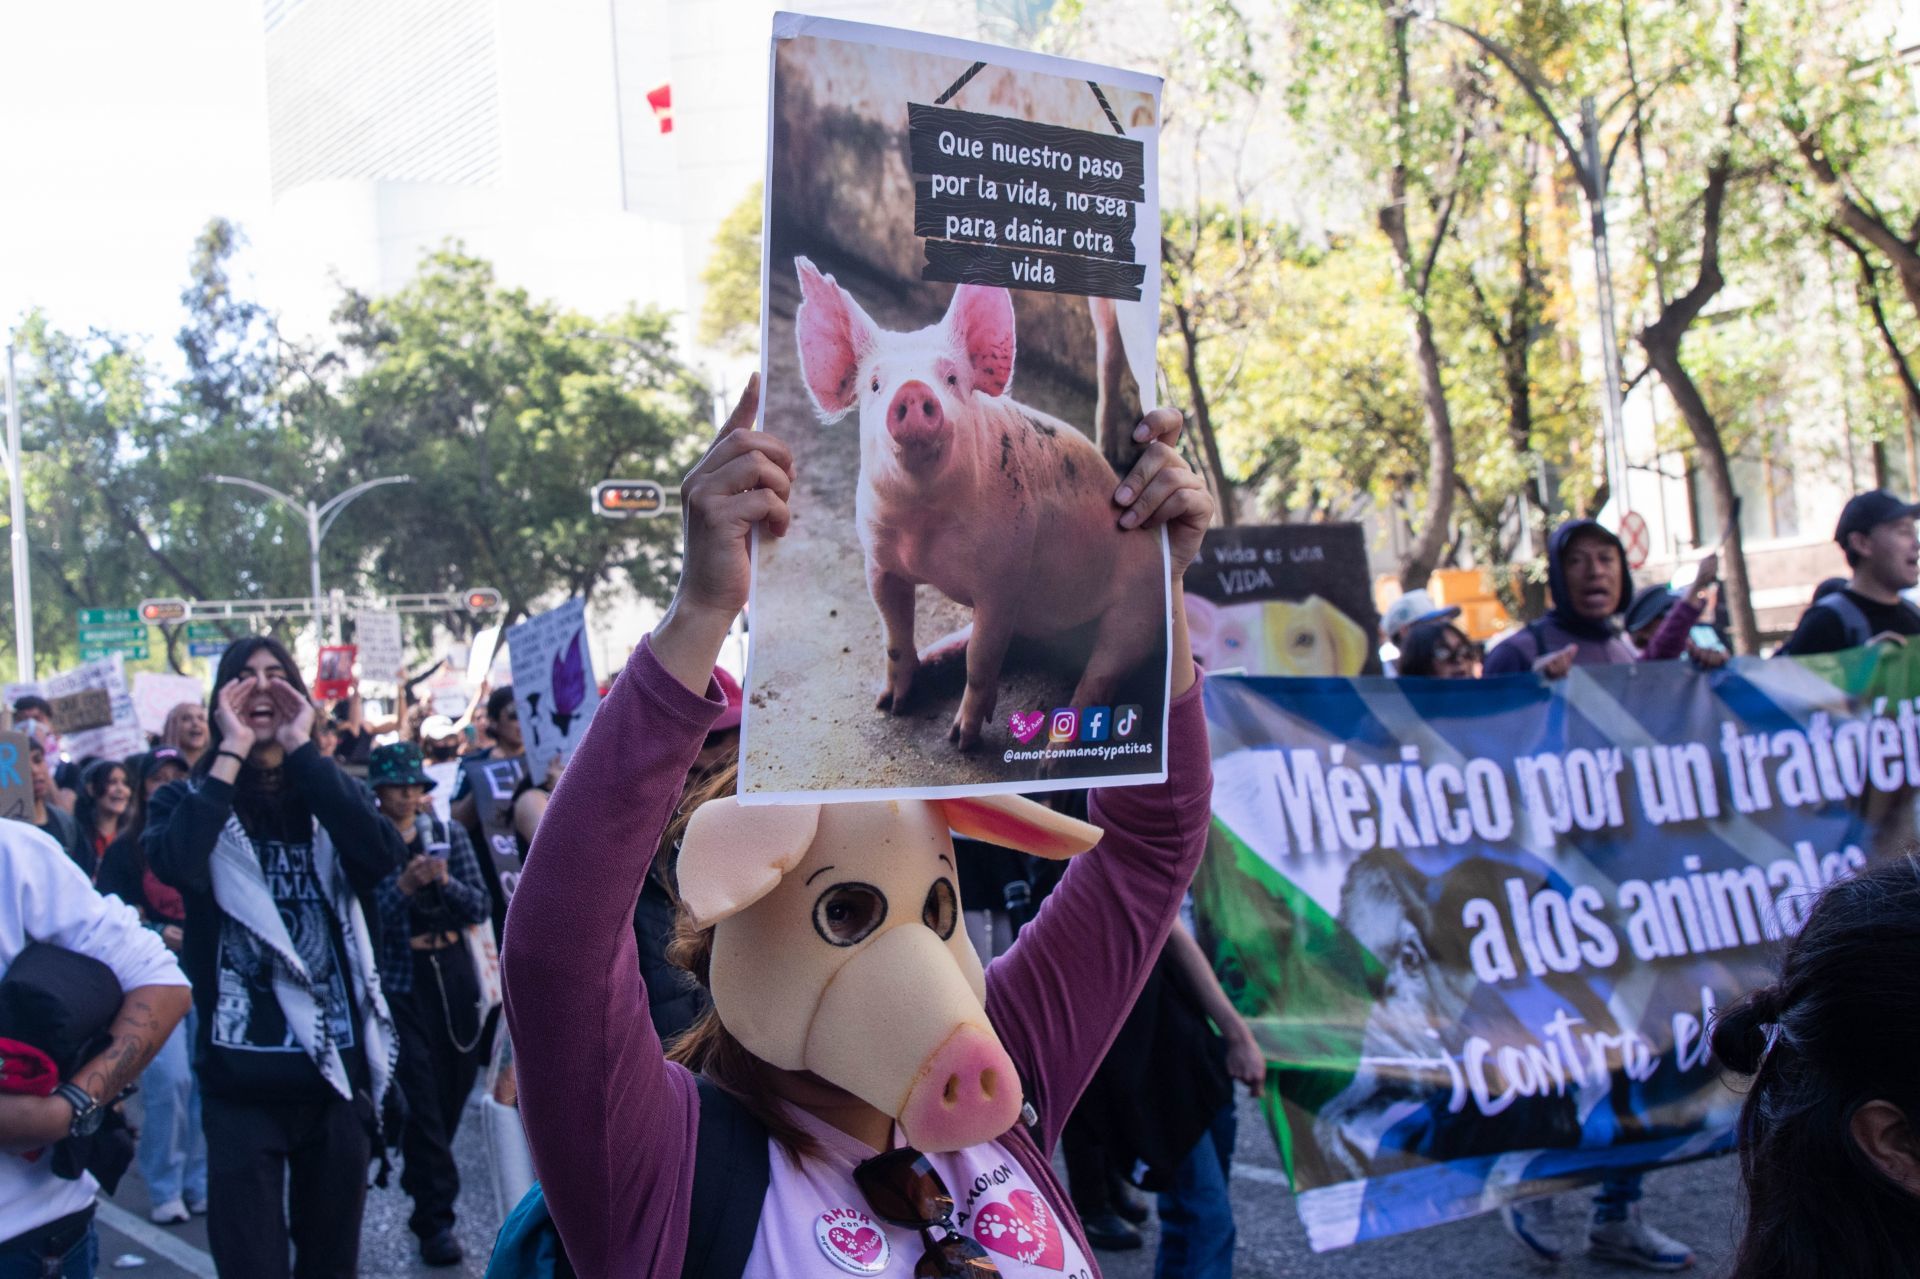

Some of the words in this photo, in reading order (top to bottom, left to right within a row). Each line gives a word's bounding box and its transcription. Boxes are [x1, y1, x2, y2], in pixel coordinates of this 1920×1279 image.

[938, 131, 983, 158] Que
[992, 142, 1072, 171] nuestro
[1078, 155, 1123, 180] paso
[931, 174, 969, 198] por
[978, 174, 997, 200] la
[1006, 178, 1057, 211] vida,
[1066, 191, 1088, 212] no
[1095, 197, 1127, 217] sea
[946, 215, 996, 239] para
[1004, 217, 1066, 247] dañar
[1073, 228, 1114, 253] otra
[1011, 256, 1055, 283] vida
[1217, 567, 1274, 594] VIDA
[1003, 742, 1153, 763] @amorconmanosypatitas
[1262, 744, 1513, 855] México
[1514, 747, 1624, 847] por
[1633, 742, 1720, 825] un
[1463, 897, 1518, 984] a
[1505, 877, 1619, 977] los
[822, 1208, 870, 1226] AMOR
